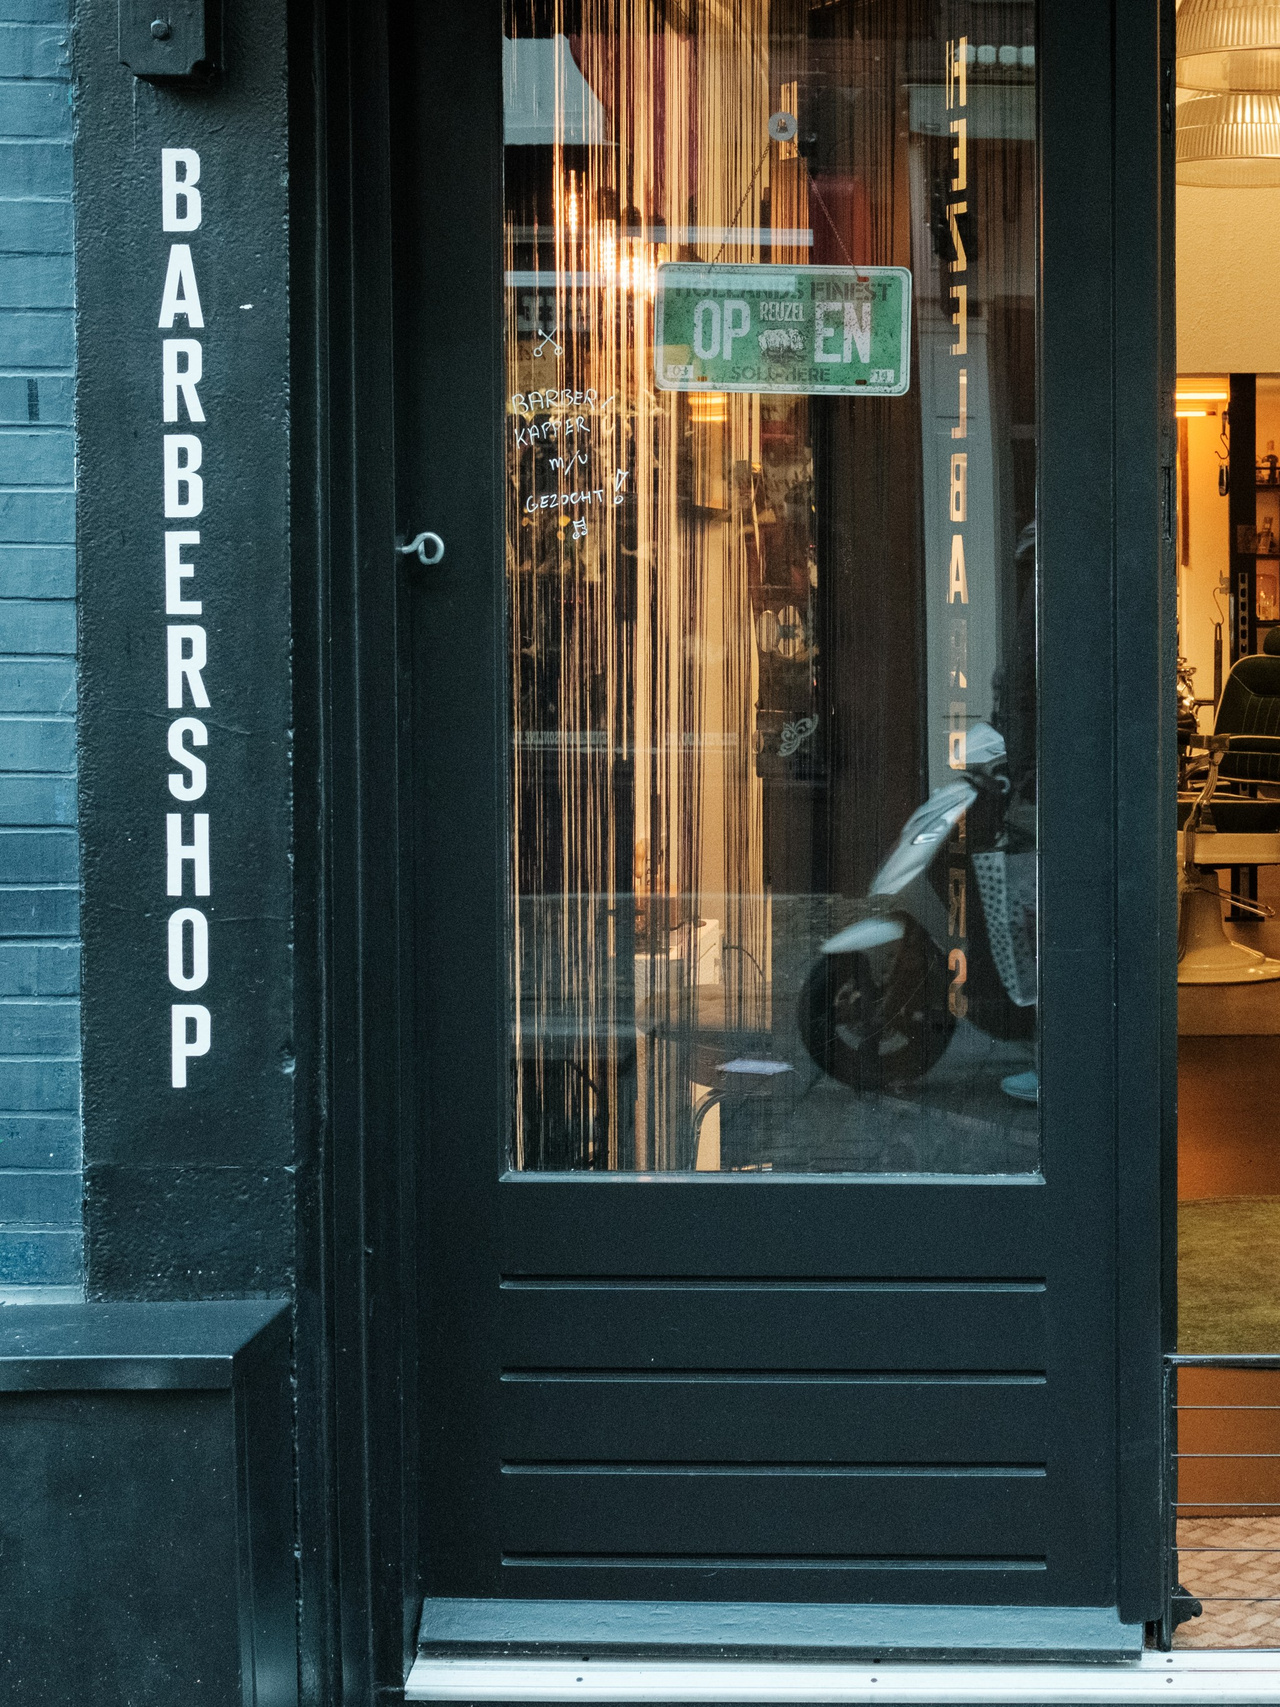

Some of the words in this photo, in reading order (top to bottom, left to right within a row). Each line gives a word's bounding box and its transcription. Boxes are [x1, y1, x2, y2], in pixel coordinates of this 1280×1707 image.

[810, 281, 893, 301] FINEST
[759, 301, 806, 322] REUZEL
[514, 416, 590, 450] KAPPER
[158, 147, 211, 1089] BARBERSHOP
